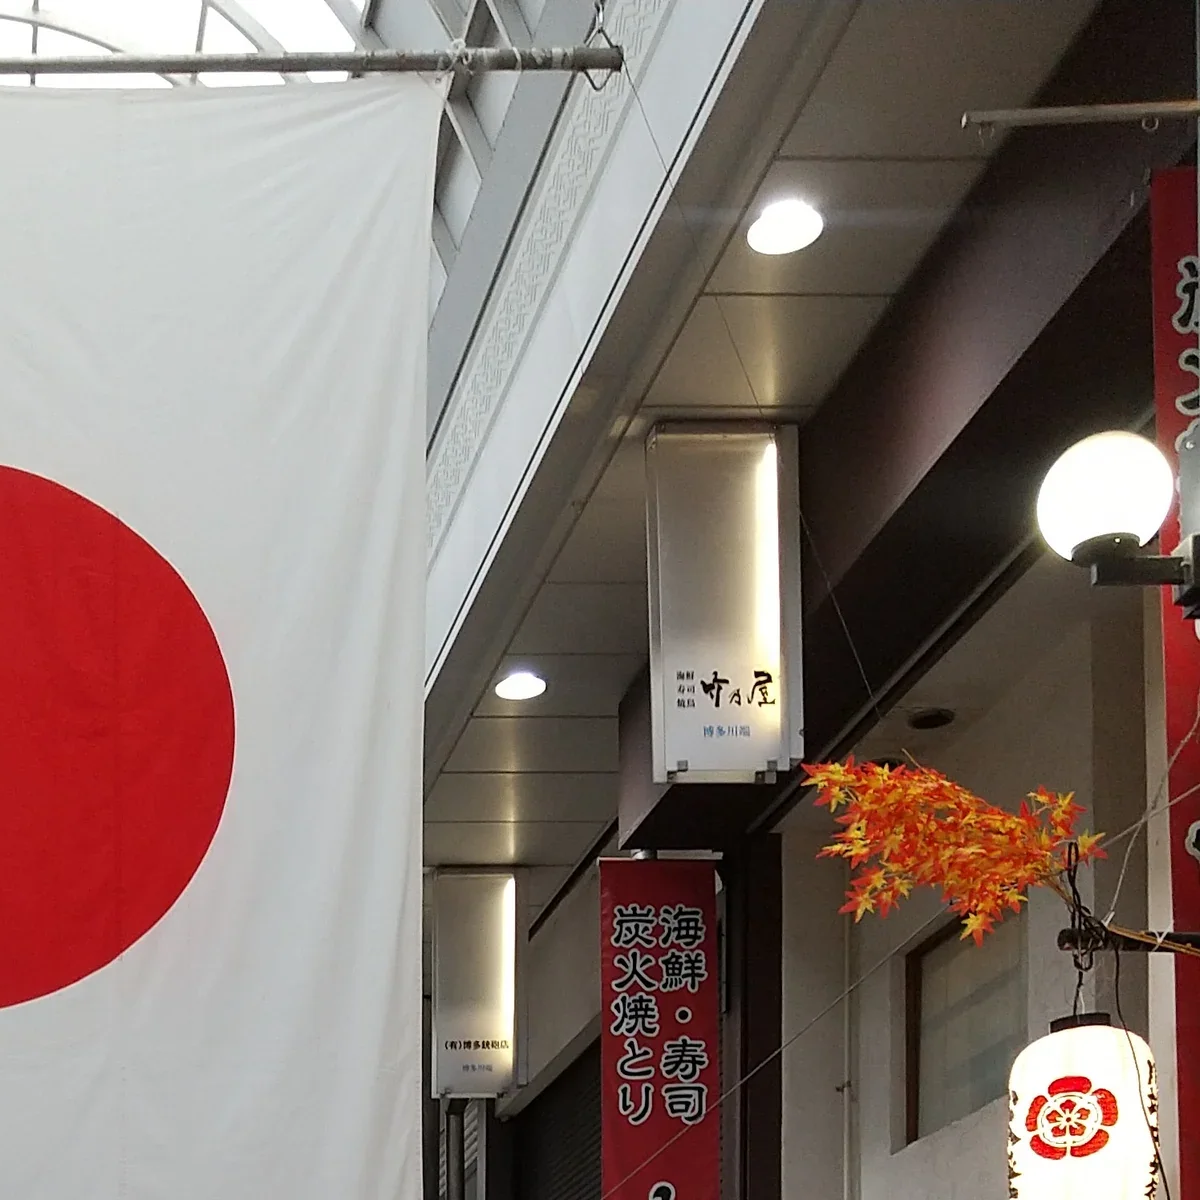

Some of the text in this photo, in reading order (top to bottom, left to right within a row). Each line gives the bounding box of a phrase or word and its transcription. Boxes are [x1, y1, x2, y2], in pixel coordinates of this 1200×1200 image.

[610, 904, 660, 1125] 炭火焼とり
[658, 904, 708, 1125] 海鮮・寿司
